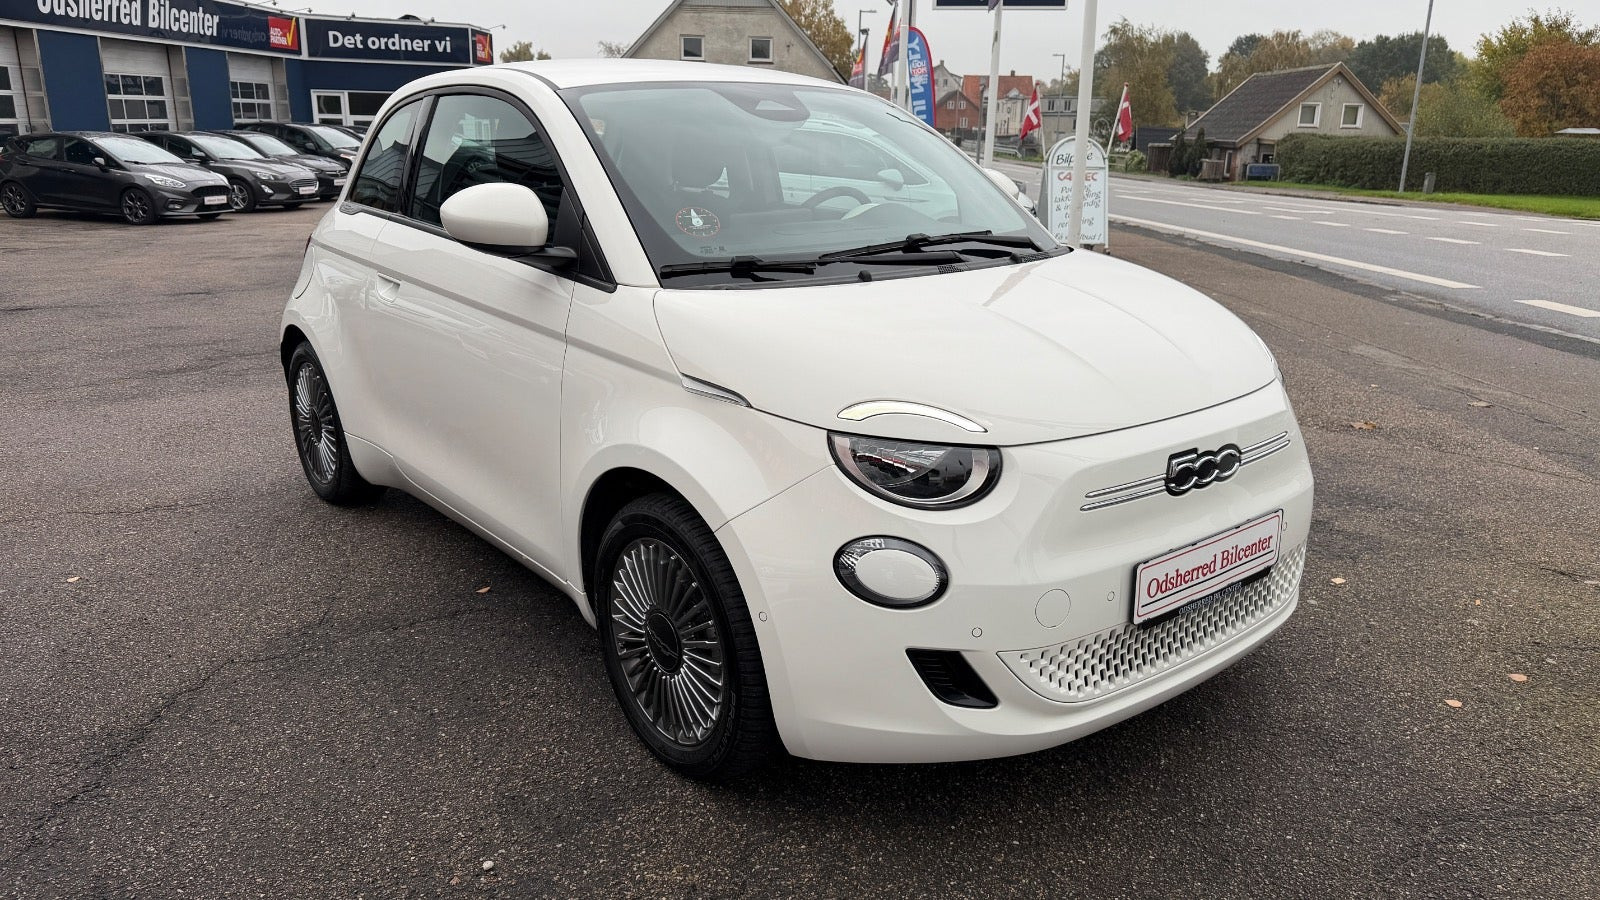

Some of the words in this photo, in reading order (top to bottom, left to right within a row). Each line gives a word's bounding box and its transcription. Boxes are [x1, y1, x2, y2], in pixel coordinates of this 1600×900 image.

[148, 0, 220, 37] Bilcenter
[328, 30, 364, 48] Det
[367, 34, 432, 51] ordner
[434, 37, 451, 53] vi
[1057, 171, 1098, 181] CAEC
[1165, 444, 1242, 496] 500
[1146, 555, 1217, 599] Odsherred
[1220, 535, 1273, 570] Bilcenter
